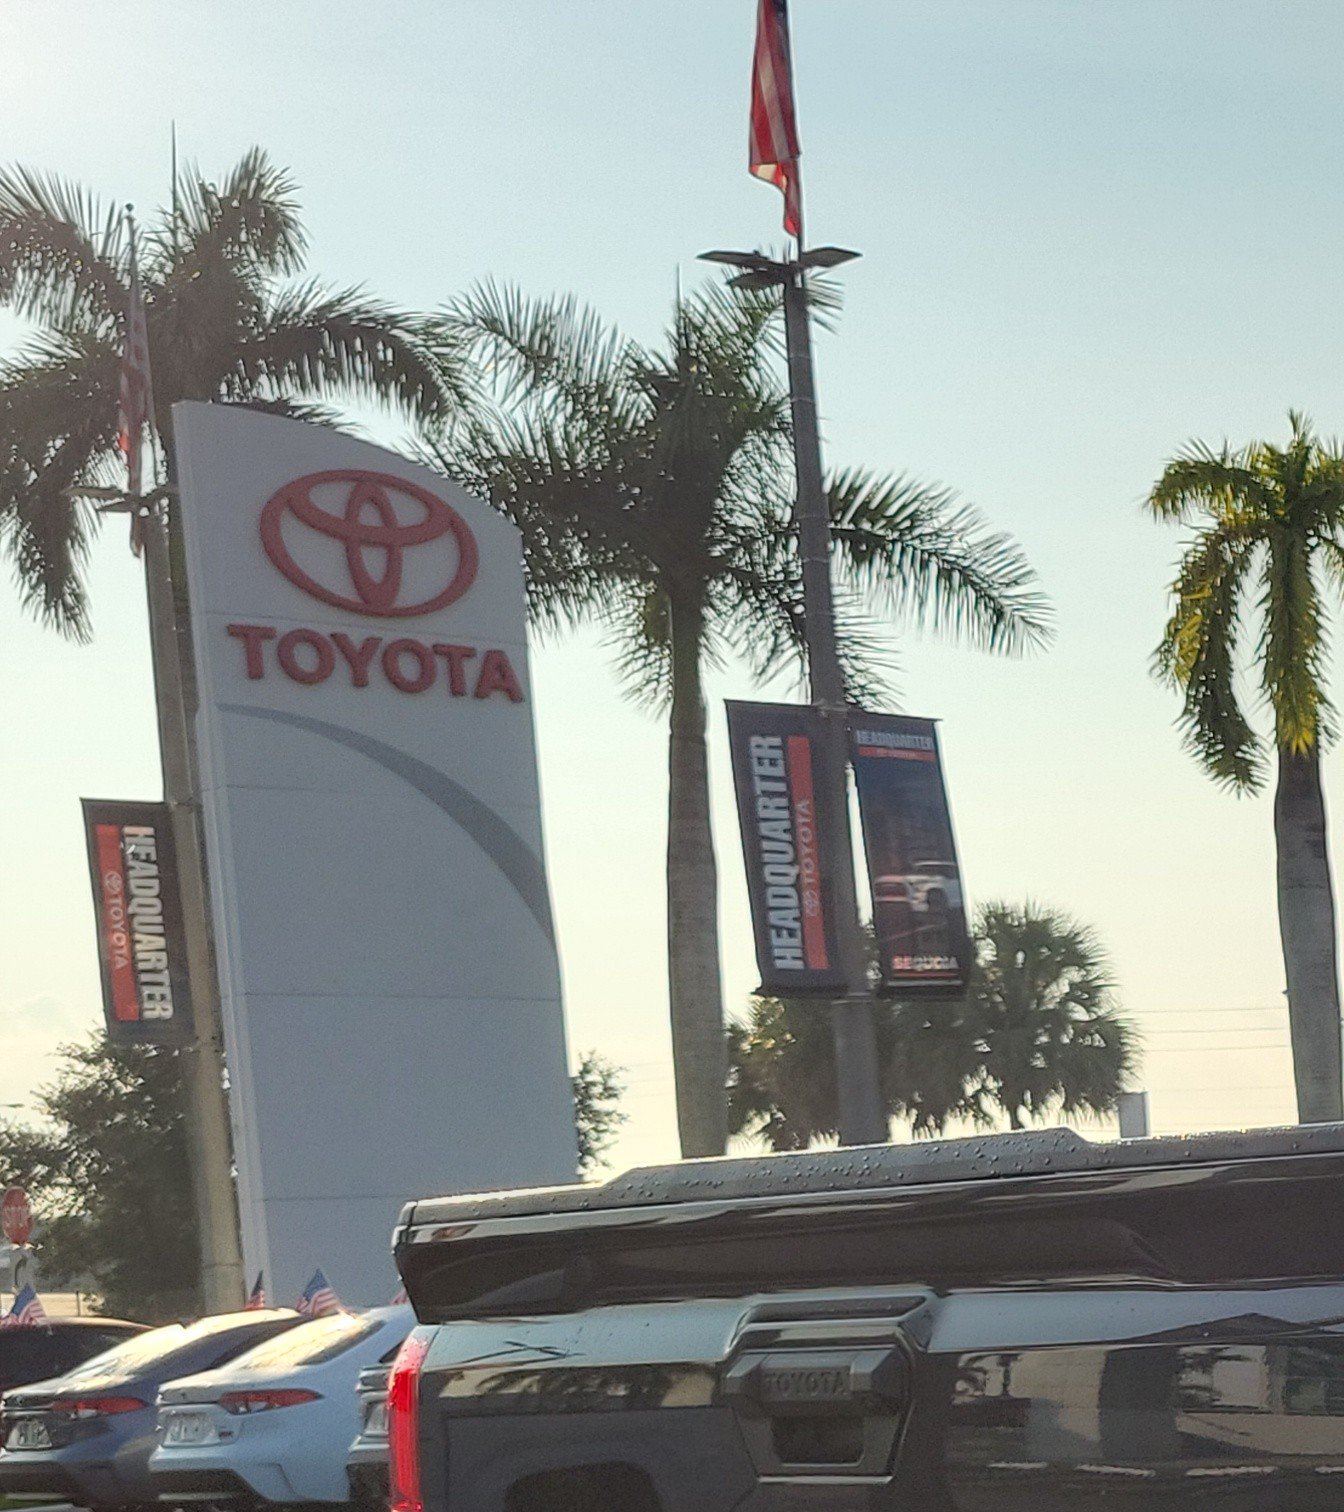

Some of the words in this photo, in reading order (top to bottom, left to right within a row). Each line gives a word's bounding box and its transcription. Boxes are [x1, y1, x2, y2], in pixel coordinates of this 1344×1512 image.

[226, 624, 524, 704] TOYOTA
[750, 735, 805, 970] HEADQUARTER
[795, 800, 820, 884] TOYOTA
[105, 894, 131, 970] TOYOTA
[122, 825, 174, 1020] HEADQUARTER
